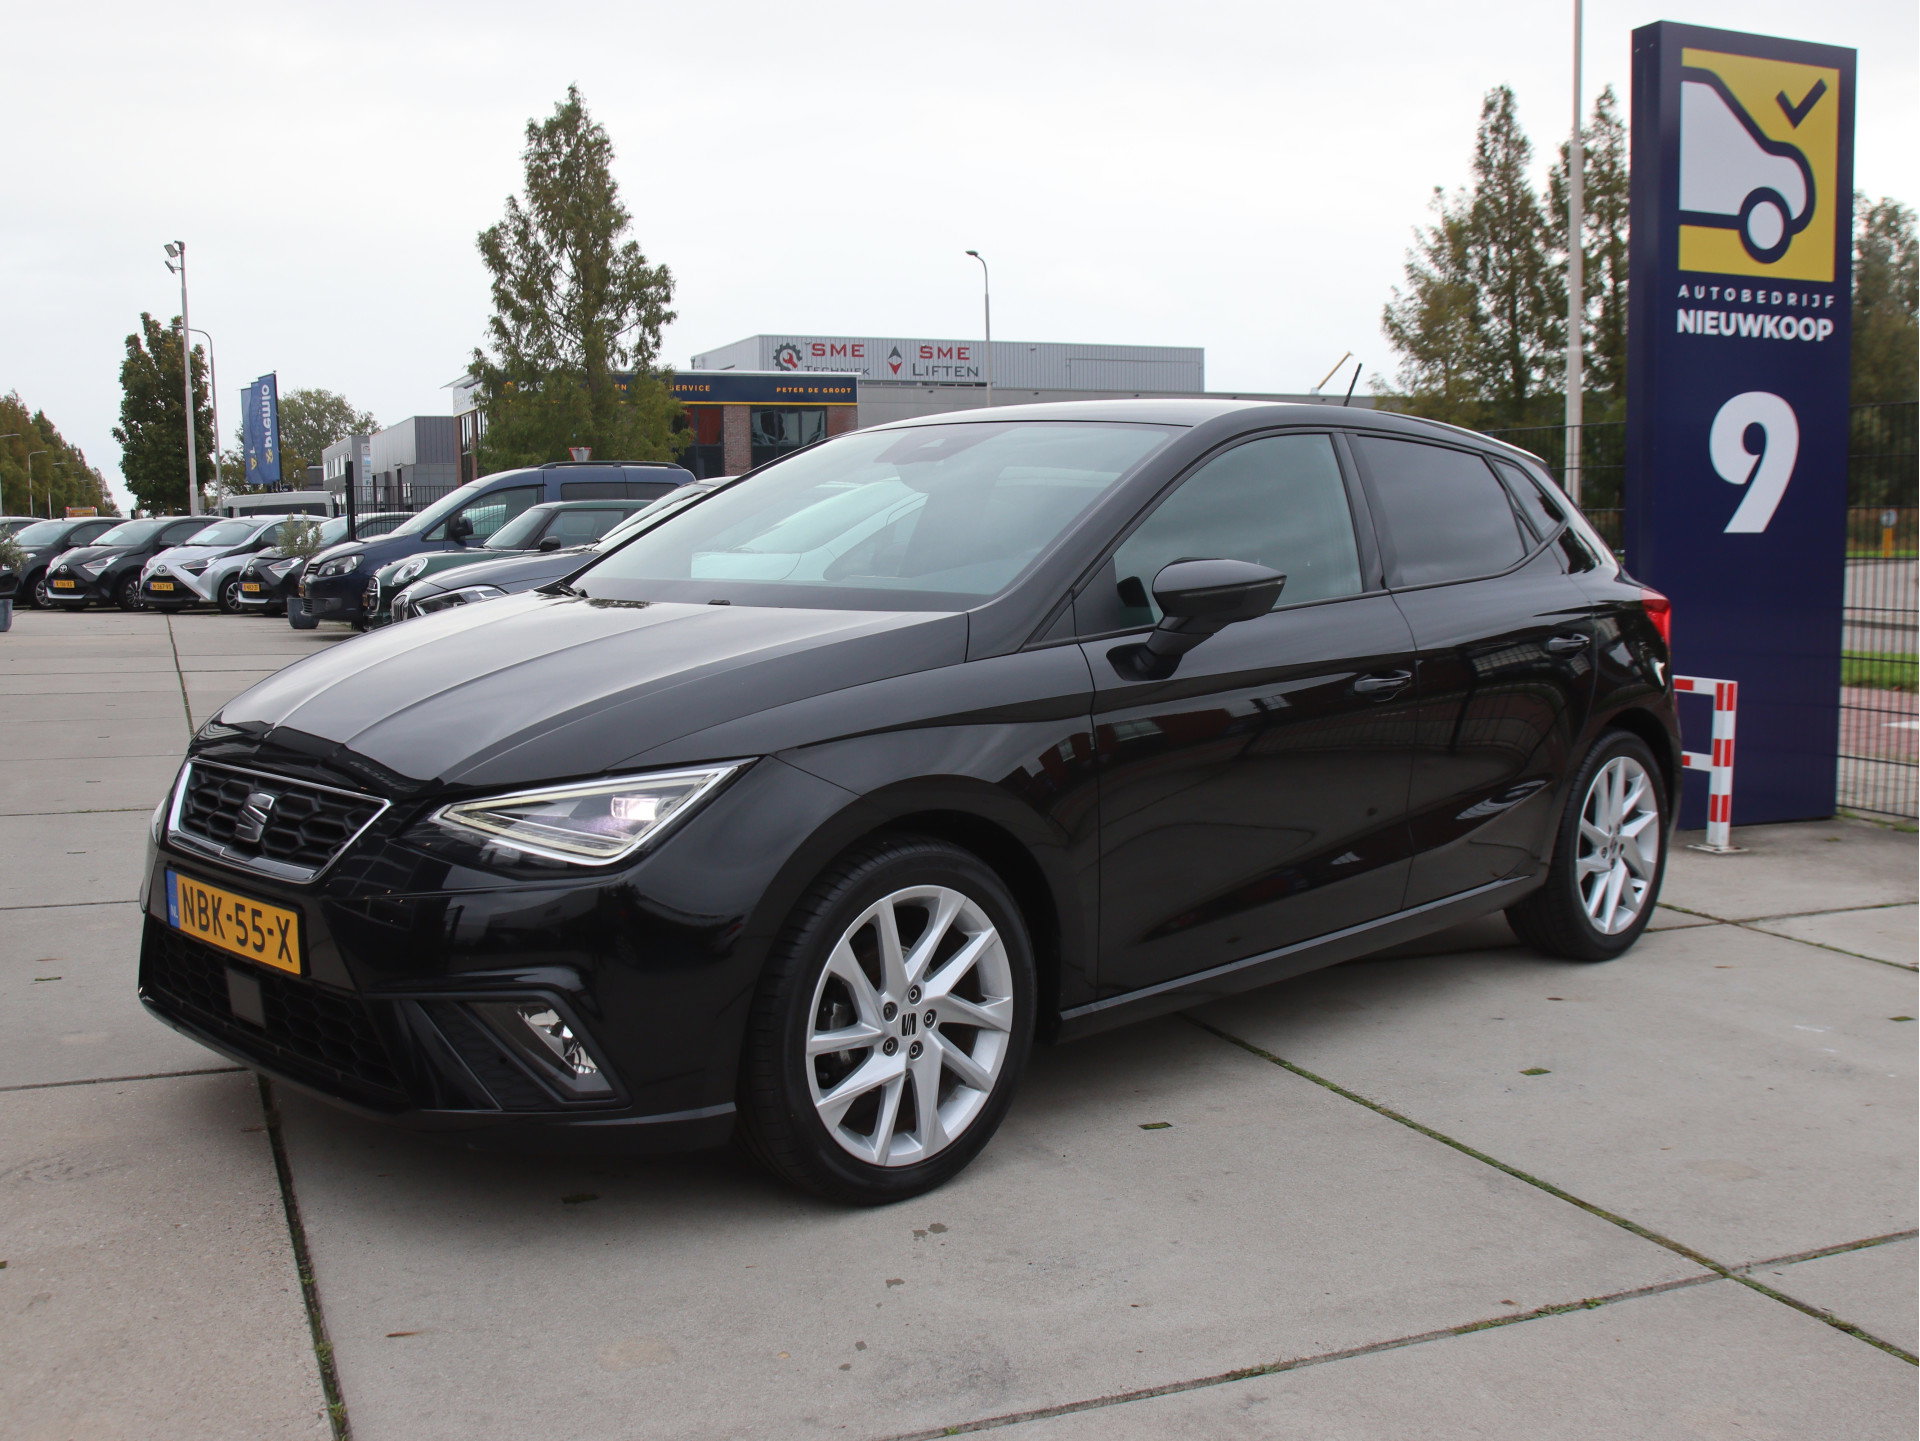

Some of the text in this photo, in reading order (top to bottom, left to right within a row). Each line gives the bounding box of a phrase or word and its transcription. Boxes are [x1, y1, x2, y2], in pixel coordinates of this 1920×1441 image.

[1677, 284, 1836, 309] AUTOBEDRIJF
[1676, 308, 1835, 342] NIEUWKOOP
[811, 342, 865, 358] SME
[919, 345, 970, 361] SME
[912, 362, 979, 378] LIFTEN
[1708, 390, 1800, 534] 9
[182, 882, 293, 964] NBK-55-X
